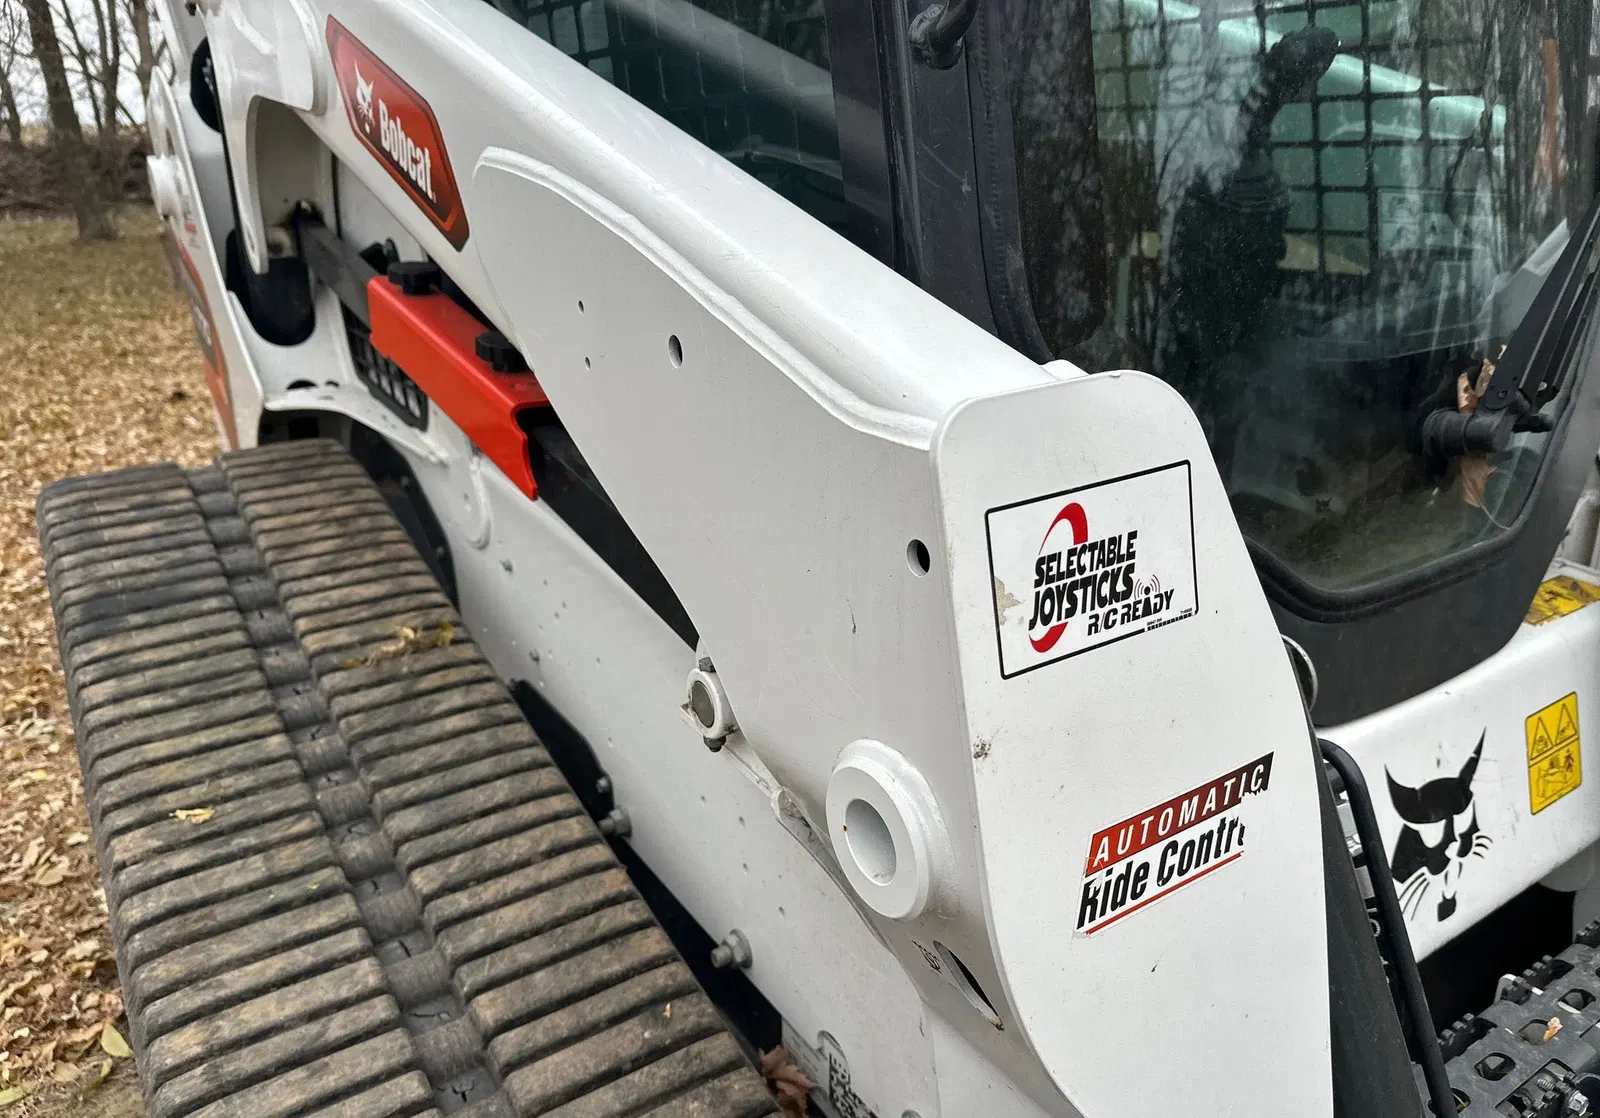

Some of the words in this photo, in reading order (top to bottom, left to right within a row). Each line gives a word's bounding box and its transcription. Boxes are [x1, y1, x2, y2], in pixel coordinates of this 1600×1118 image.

[378, 98, 433, 200] Bobcat
[1033, 529, 1138, 589] SELECTABLE
[1028, 562, 1136, 632] JOYSTICKS
[1087, 608, 1118, 637] R/C
[1120, 587, 1175, 626] READY
[1092, 763, 1265, 867] AUTOMATIC
[1076, 860, 1150, 930] Ride
